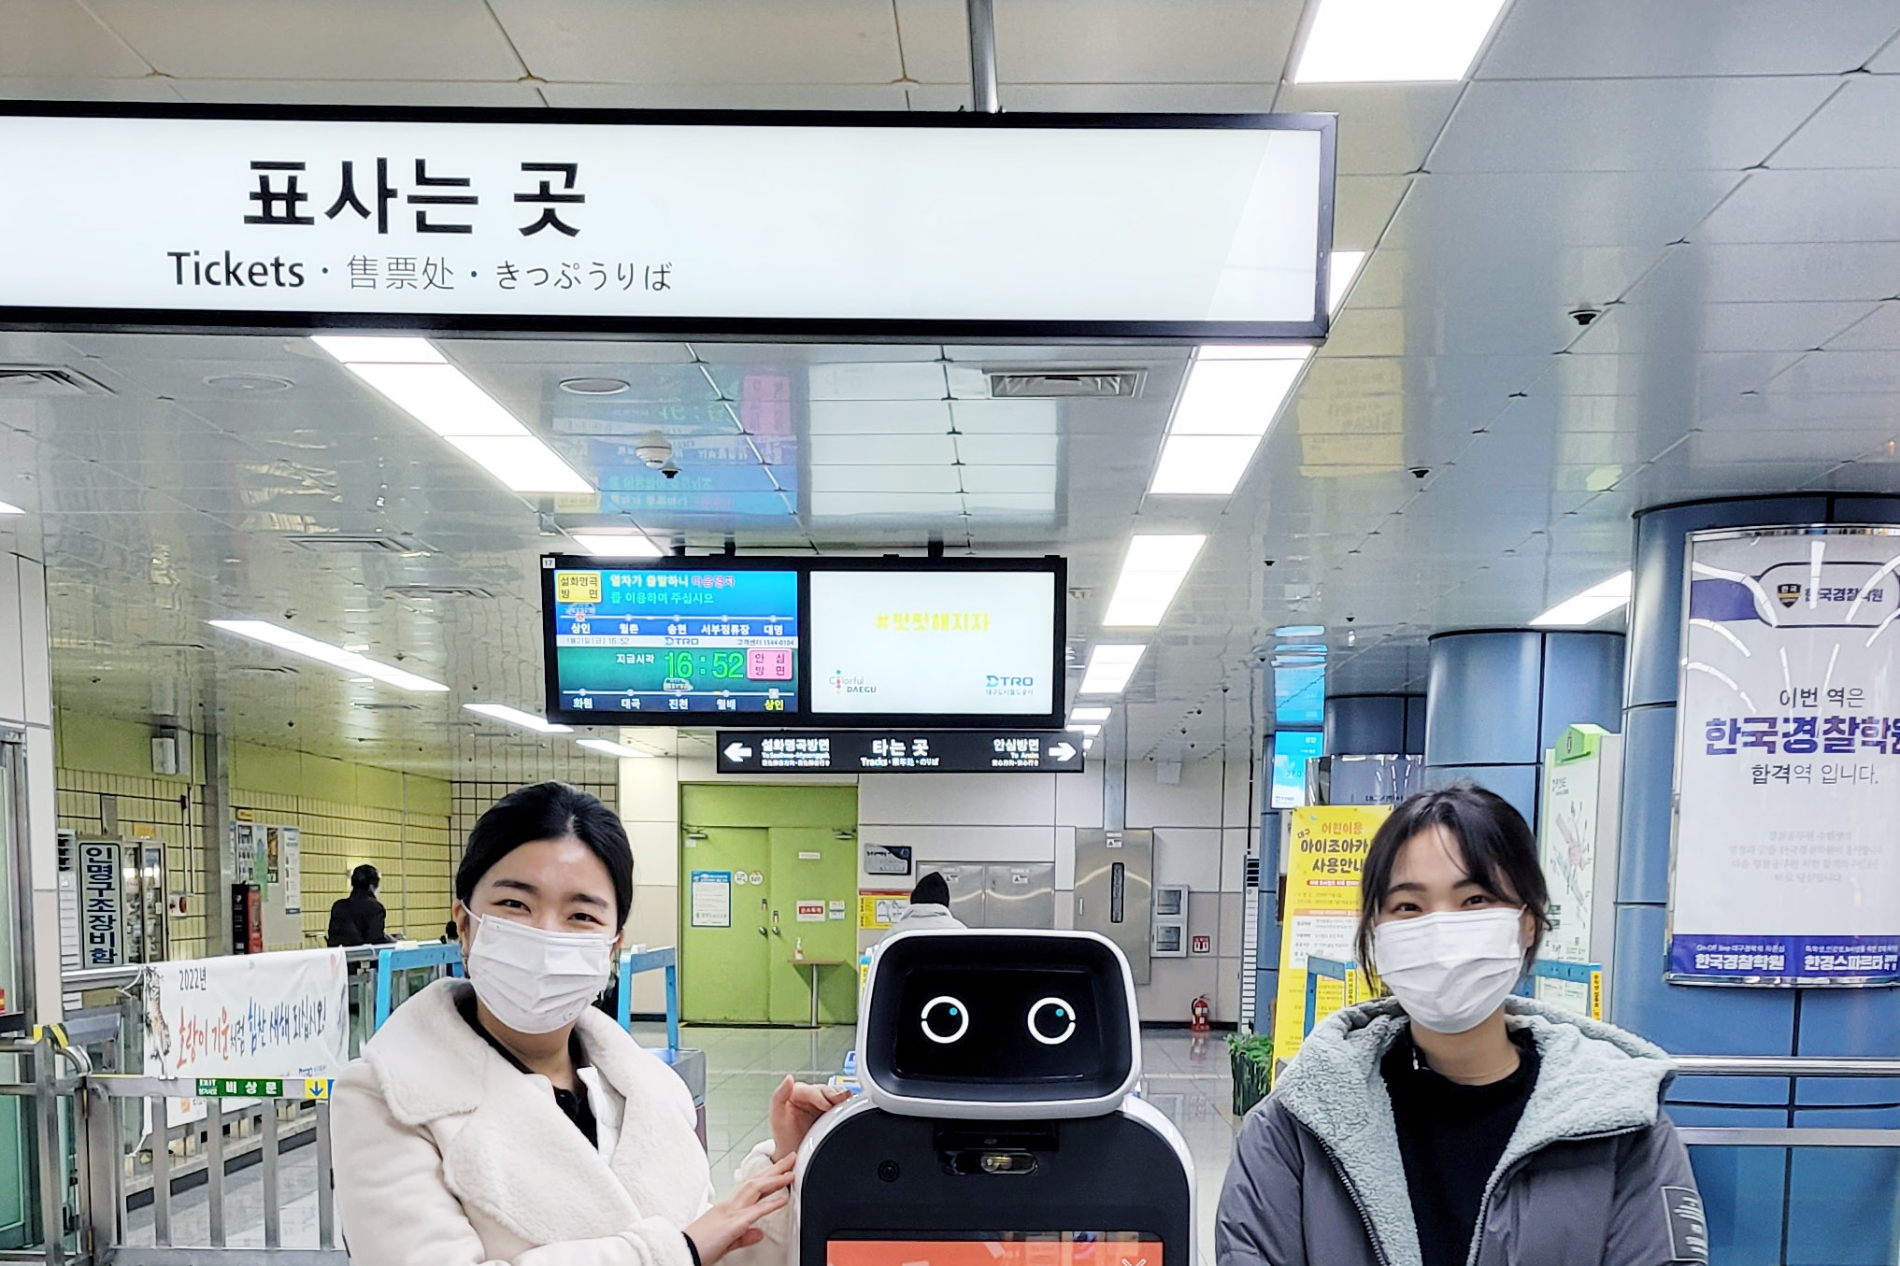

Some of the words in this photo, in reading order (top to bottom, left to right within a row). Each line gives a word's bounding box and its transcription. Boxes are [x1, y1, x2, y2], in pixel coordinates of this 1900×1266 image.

[243, 157, 480, 234] 표사는
[513, 160, 587, 238] 곳
[167, 250, 305, 288] Tickets
[348, 255, 455, 291] 售票处
[495, 258, 673, 292] きっぷうりば
[560, 576, 598, 587] 설화명곡
[616, 653, 655, 665] 지금시각
[664, 651, 744, 679] 16:52
[846, 685, 877, 693] DAEGU
[1779, 687, 1818, 708] 이번
[1827, 687, 1866, 708] 역은
[872, 738, 906, 757] 타는
[912, 738, 929, 757] 곳
[993, 738, 1039, 752] 안심방면
[1705, 715, 1900, 756] 한국경찰학
[1751, 763, 1812, 785] 합격역
[85, 847, 118, 965] 인명구조장비함
[1695, 954, 1785, 971] 한국경찰학원
[179, 966, 207, 992] 2022년
[176, 1006, 208, 1069] 호랑이
[225, 1080, 277, 1095] 비상문
